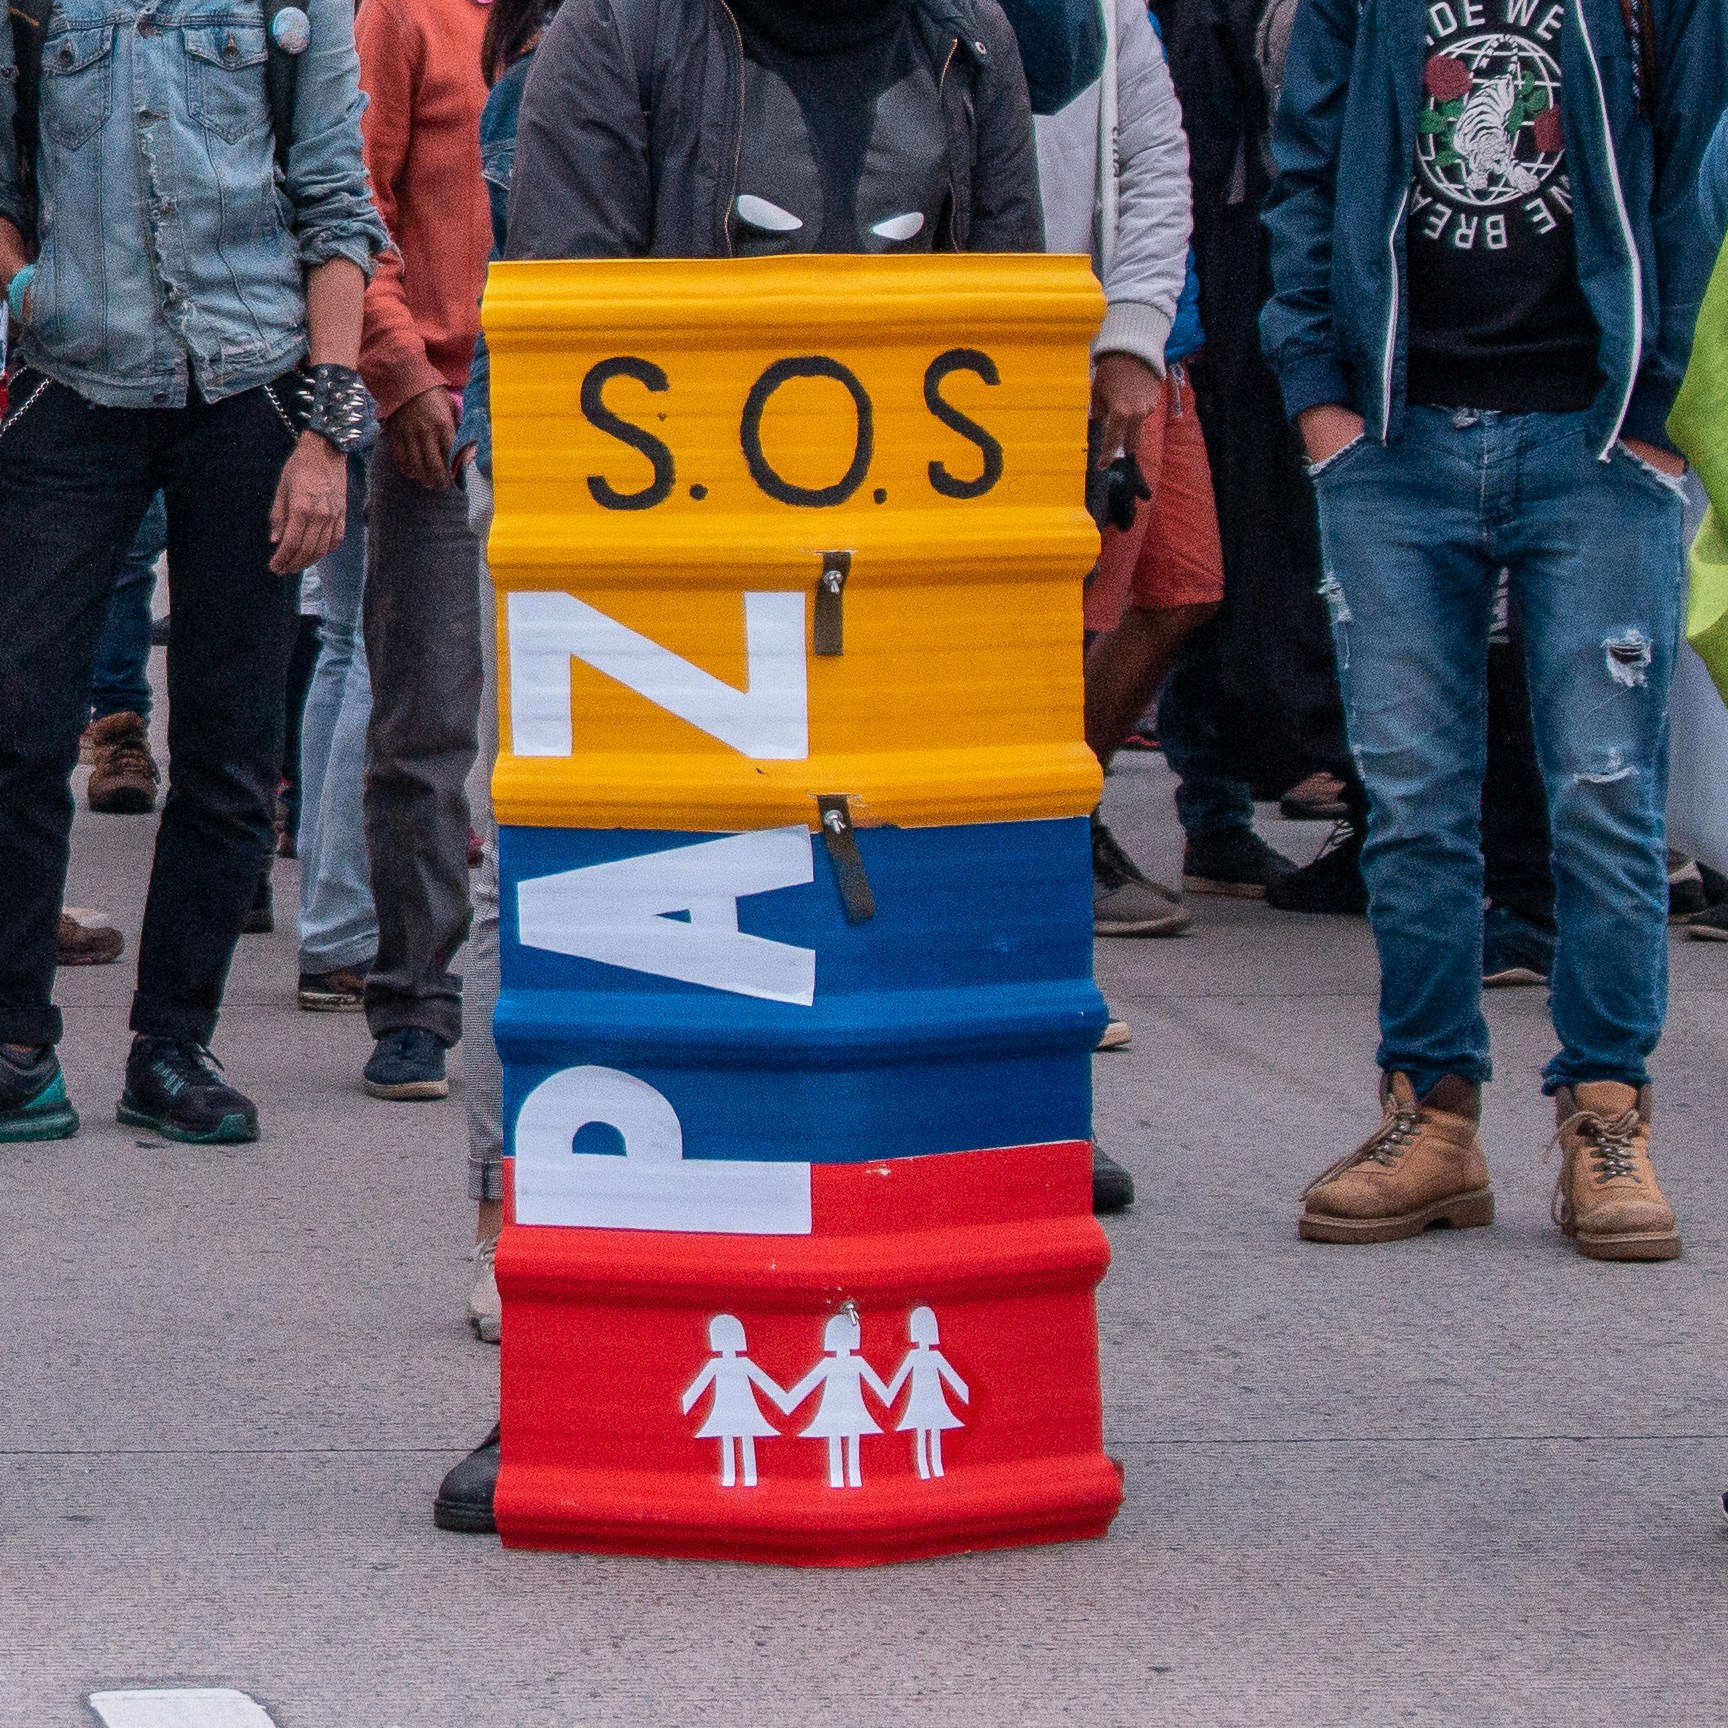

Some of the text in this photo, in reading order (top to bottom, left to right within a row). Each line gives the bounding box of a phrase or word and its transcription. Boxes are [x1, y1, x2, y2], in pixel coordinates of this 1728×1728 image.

[1410, 175, 1508, 250] BREA
[580, 348, 1004, 511] S.O.S
[507, 591, 816, 1236] PAZ
